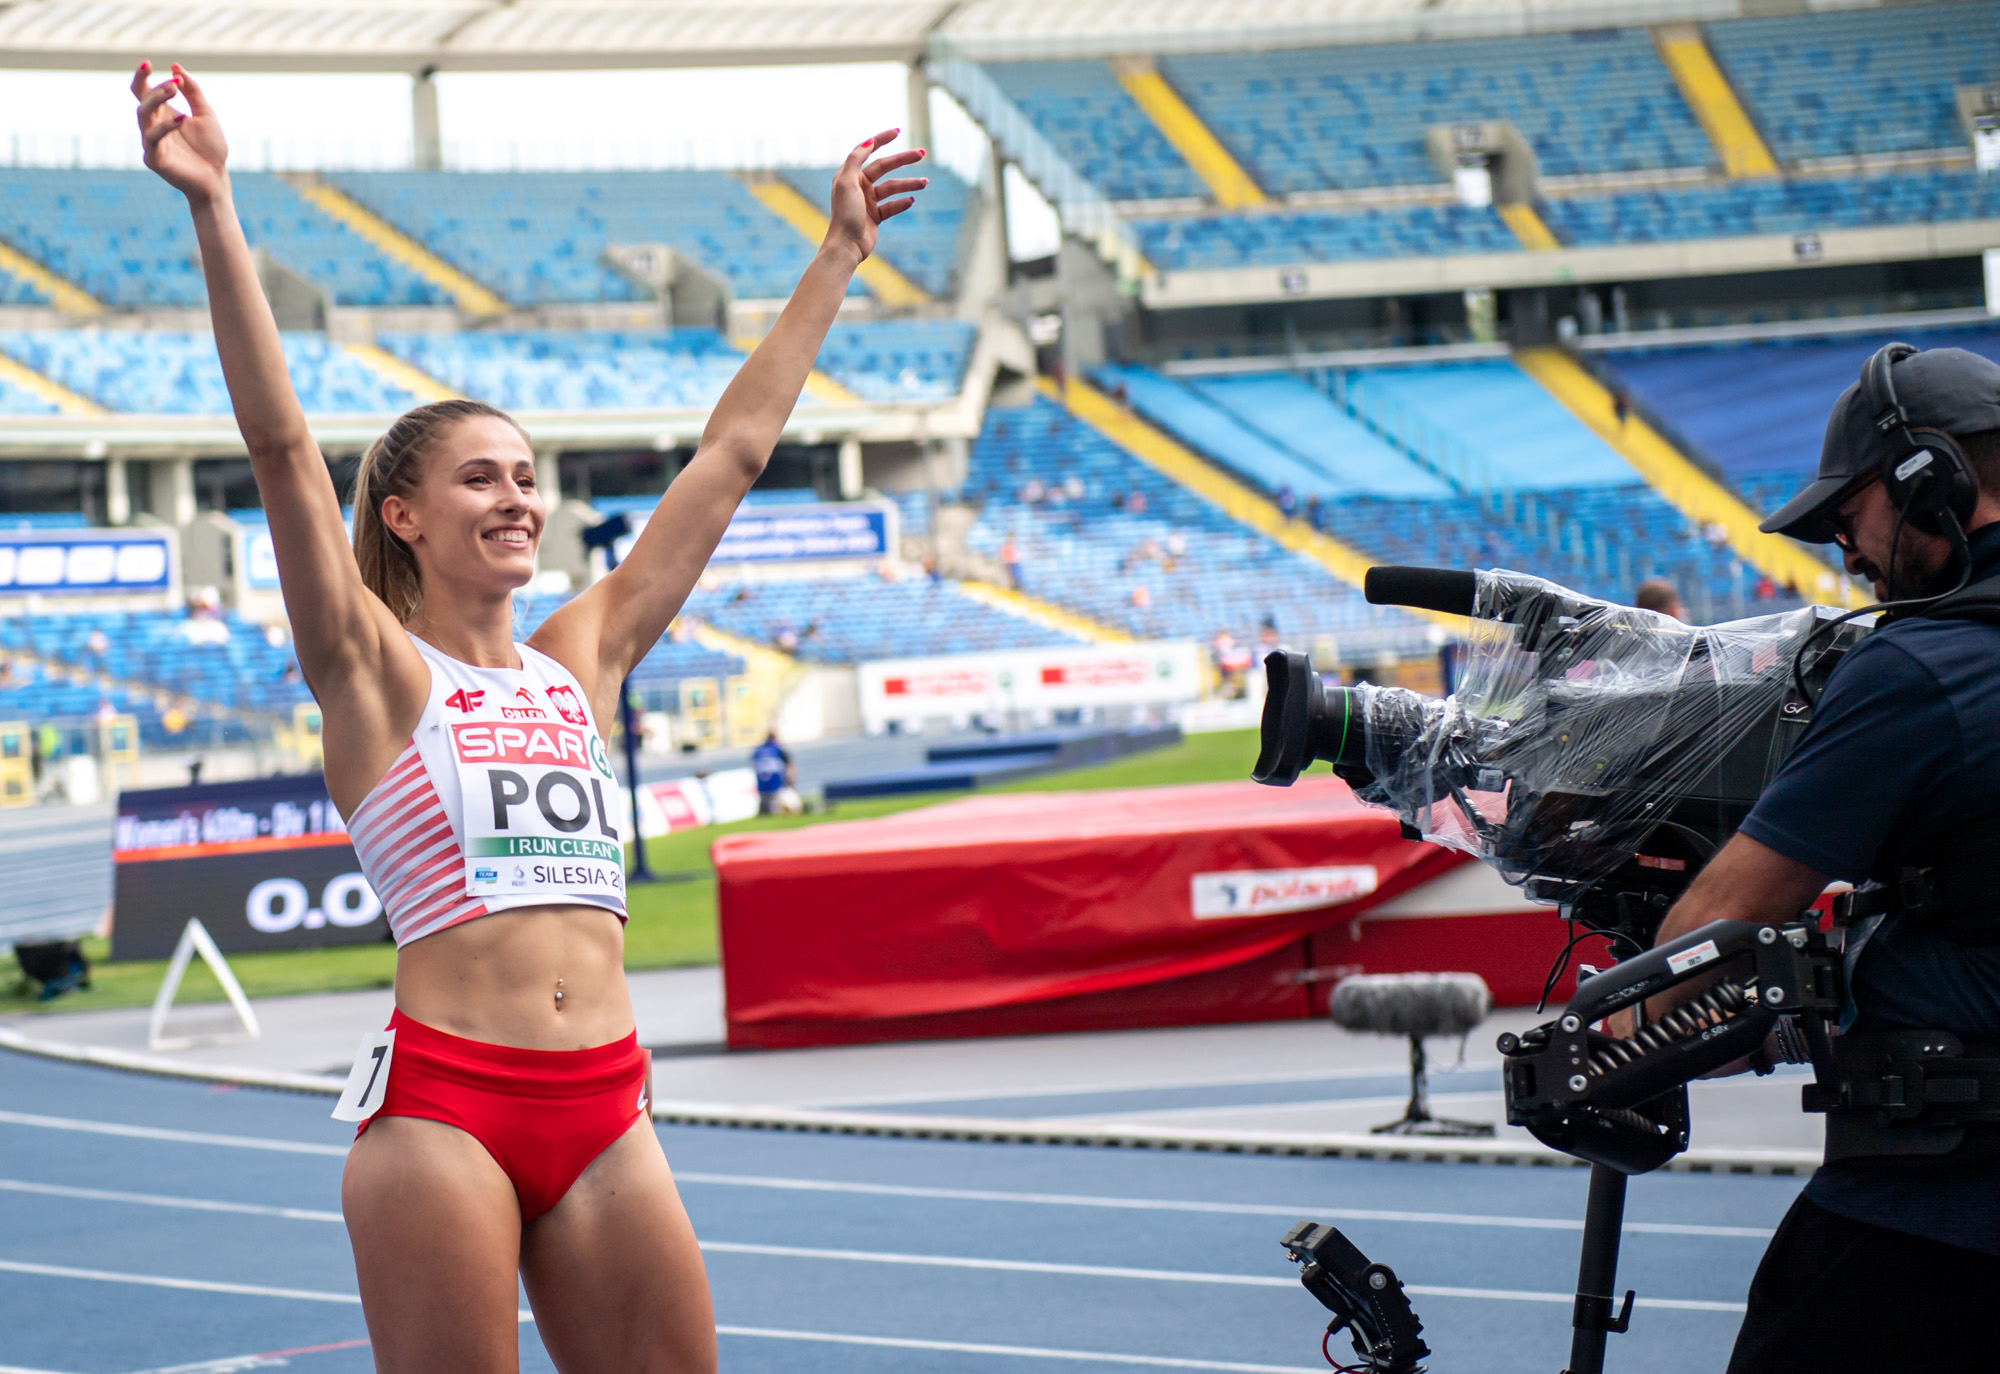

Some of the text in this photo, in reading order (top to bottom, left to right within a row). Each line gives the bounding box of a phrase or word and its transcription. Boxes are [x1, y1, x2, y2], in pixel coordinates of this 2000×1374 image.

[445, 688, 485, 713] 4F
[503, 708, 546, 719] ORLEN
[458, 727, 587, 764] SPAR
[488, 769, 618, 842] POL
[509, 841, 515, 854] I
[519, 839, 557, 855] RUN
[533, 865, 607, 886] SILESIA
[357, 1045, 388, 1107] 7
